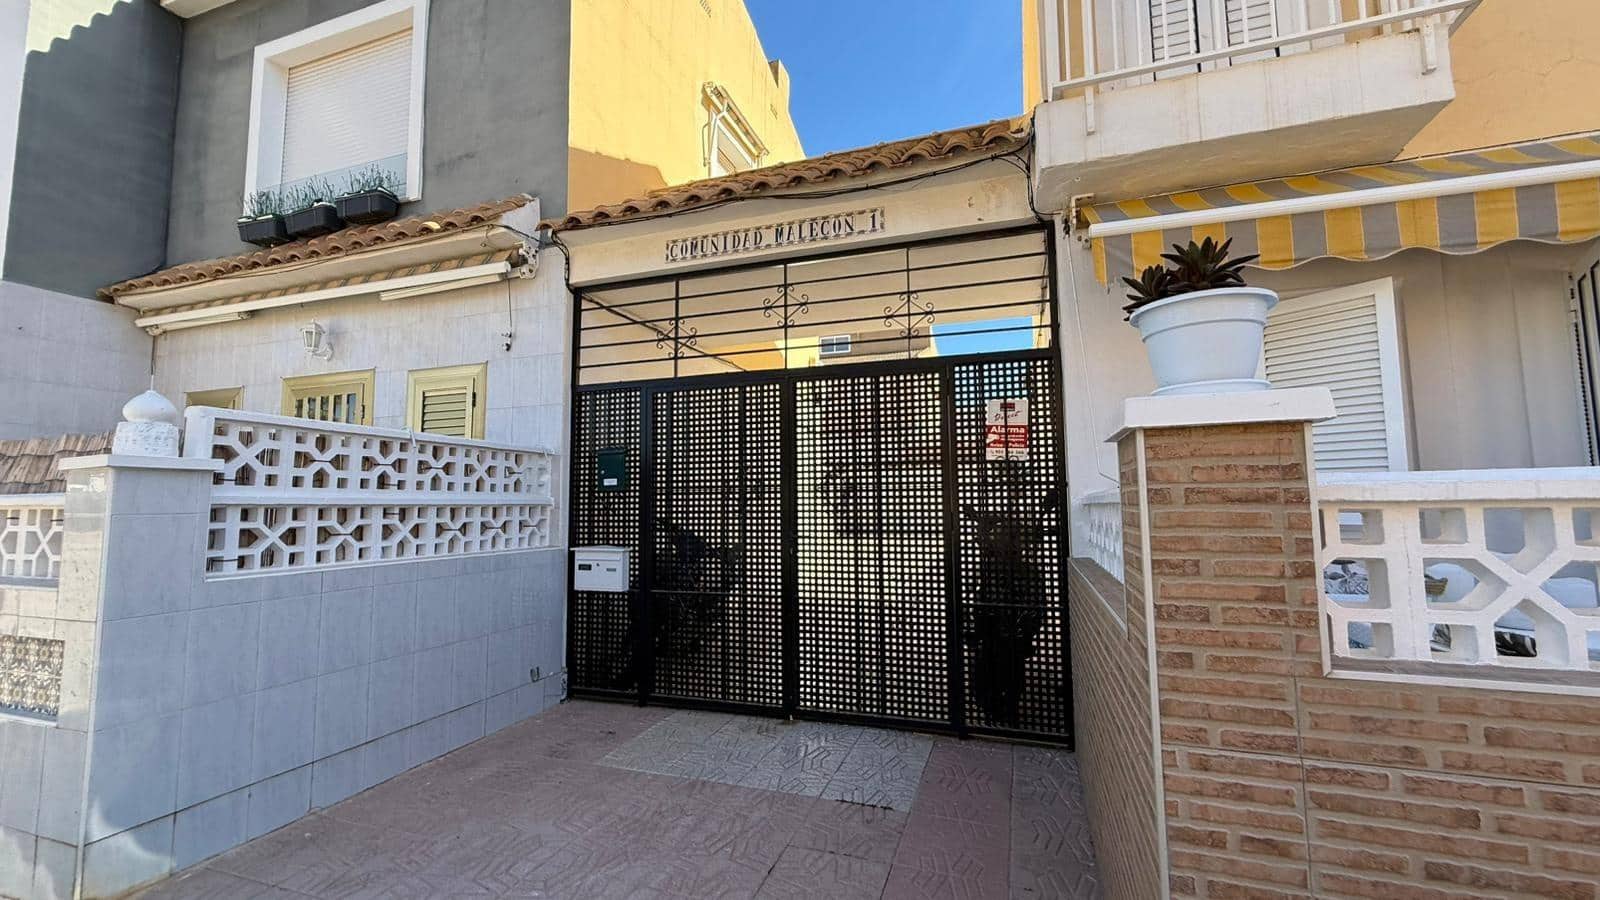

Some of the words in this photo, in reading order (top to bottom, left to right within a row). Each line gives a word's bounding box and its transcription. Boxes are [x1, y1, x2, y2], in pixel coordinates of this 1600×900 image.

[669, 230, 763, 258] COMUNIDAD
[869, 212, 878, 230] 1
[990, 425, 1025, 433] Alarma
